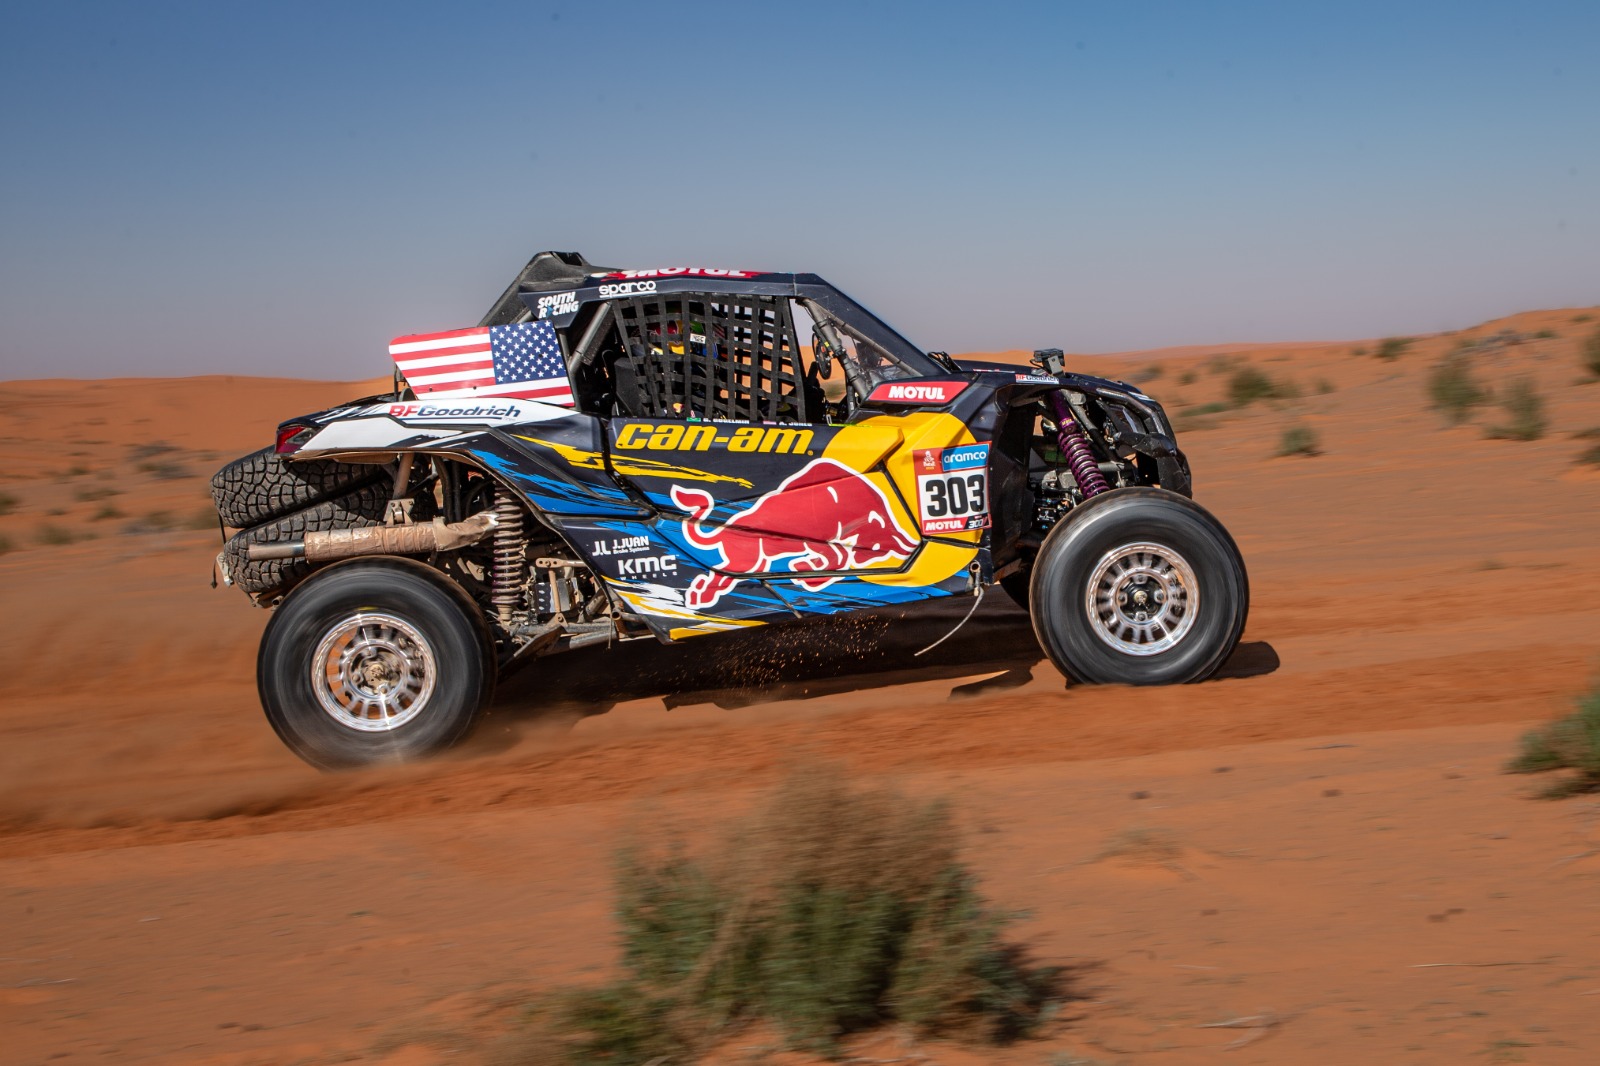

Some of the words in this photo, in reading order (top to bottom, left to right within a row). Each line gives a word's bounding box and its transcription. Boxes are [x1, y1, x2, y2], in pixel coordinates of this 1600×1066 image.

[598, 280, 657, 297] sparco
[537, 291, 576, 309] SOUTH
[888, 386, 946, 400] MOTUL
[389, 404, 521, 418] BFGoodrich
[615, 423, 814, 455] can-am
[943, 451, 987, 464] aramco
[925, 474, 985, 517] 303
[925, 520, 963, 531] MOTUL
[612, 536, 650, 550] J.JUAN
[620, 571, 678, 581] WHEELS
